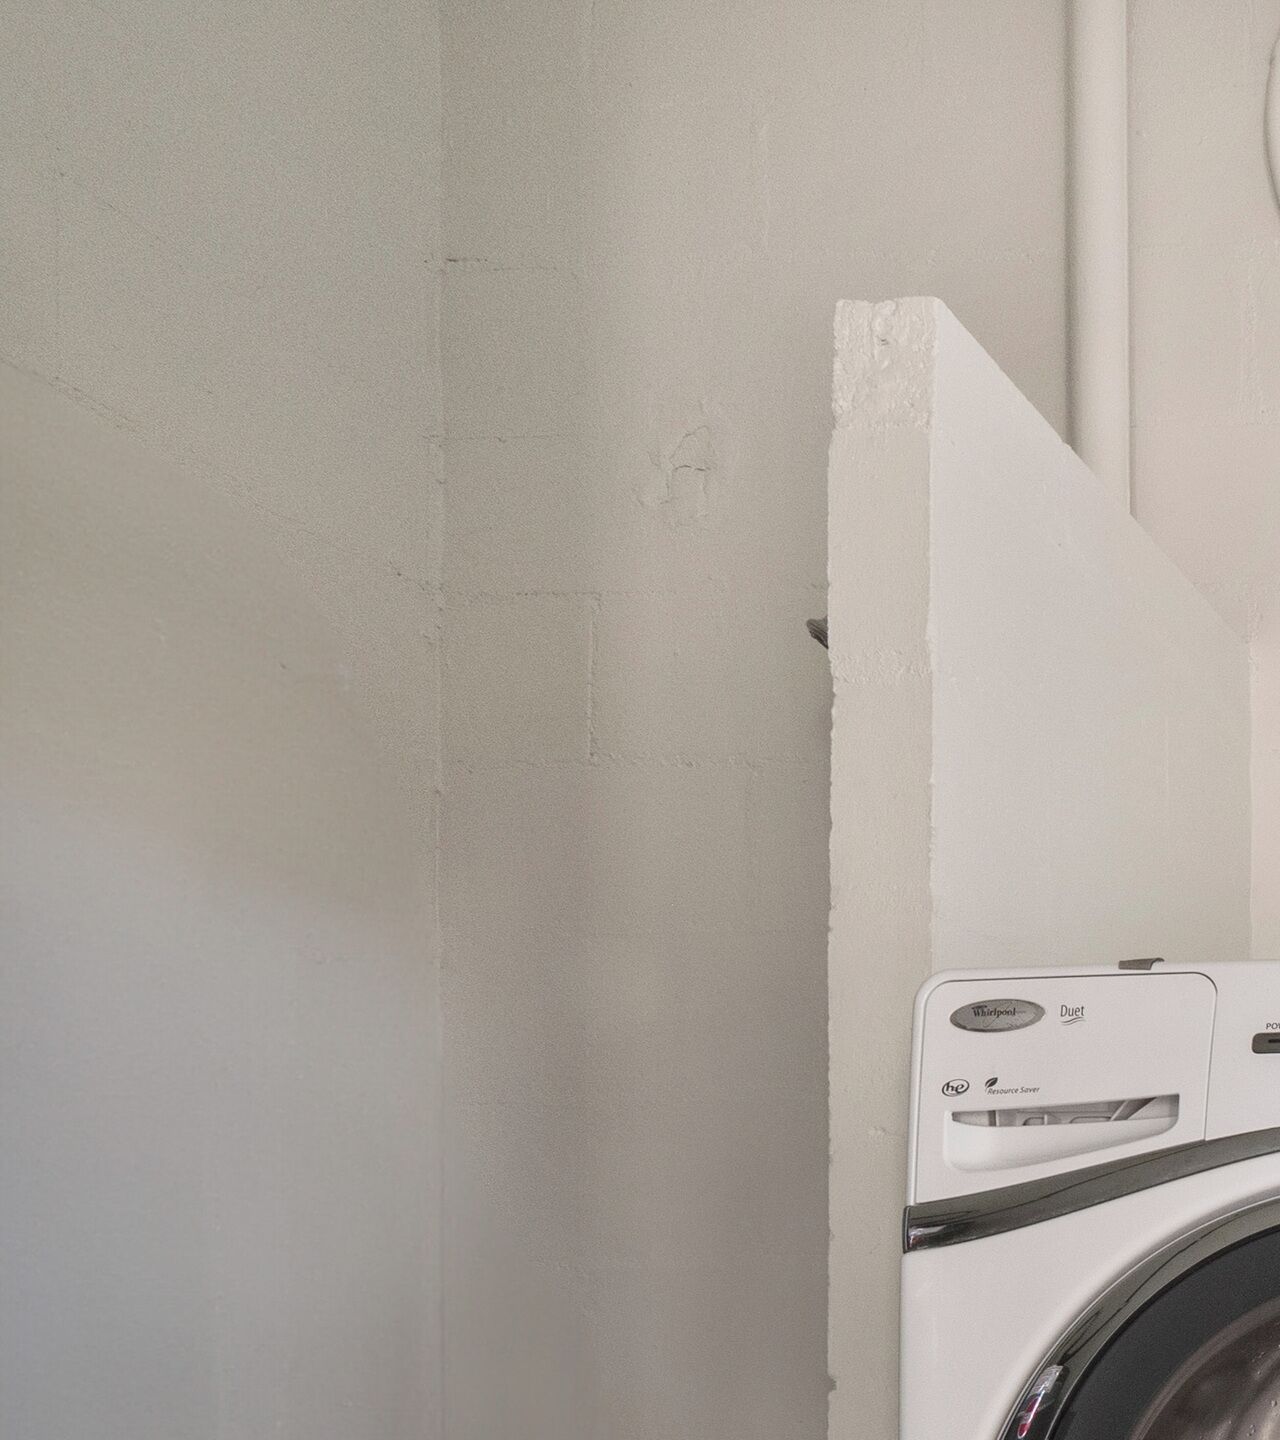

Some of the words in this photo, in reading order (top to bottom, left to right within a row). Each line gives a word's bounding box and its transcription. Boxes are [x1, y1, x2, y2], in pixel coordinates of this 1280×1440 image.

[972, 1006, 1016, 1018] Whirlpool
[1060, 1004, 1085, 1017] Duet
[944, 1080, 968, 1096] he
[987, 1087, 1018, 1095] Resource
[1019, 1086, 1040, 1094] Saver
